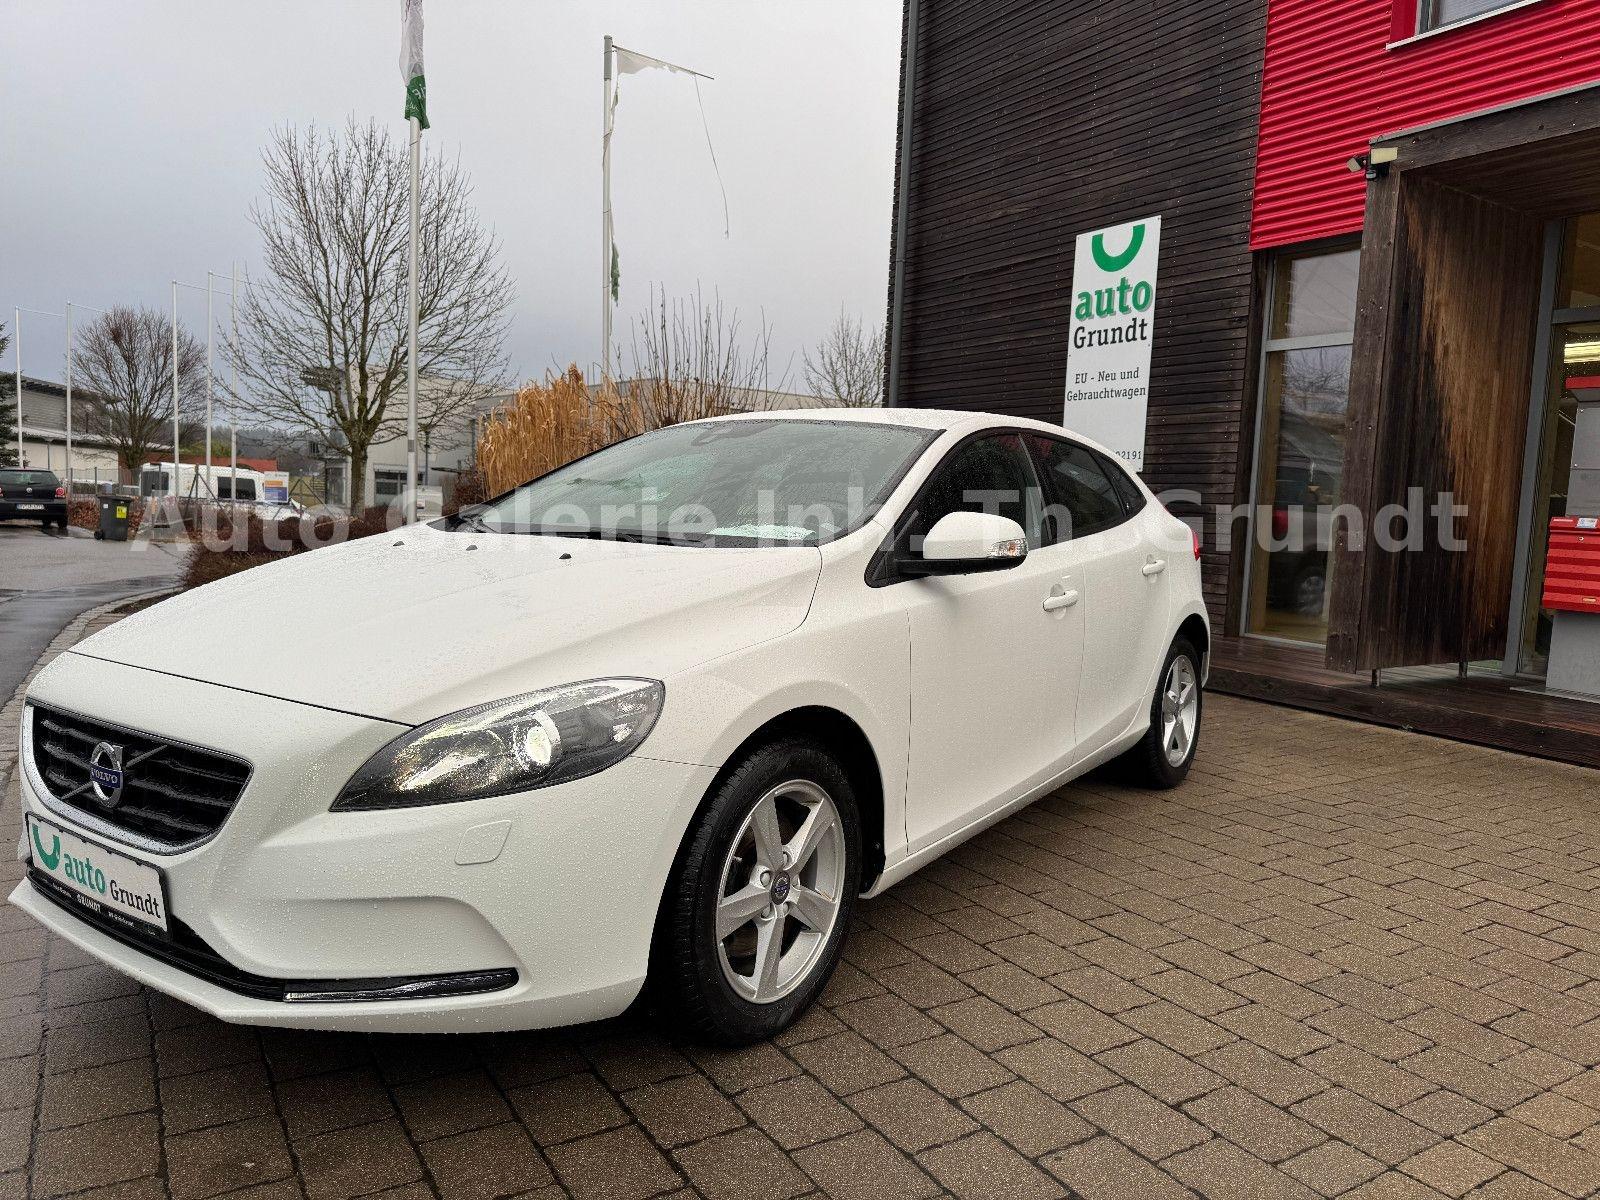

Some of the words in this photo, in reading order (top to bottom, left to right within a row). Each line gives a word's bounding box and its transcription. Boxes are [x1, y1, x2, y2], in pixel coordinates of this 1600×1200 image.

[1075, 277, 1153, 321] auto
[1073, 317, 1148, 349] Grundt
[1075, 373, 1088, 384] EU
[1098, 371, 1117, 382] Neu
[1120, 366, 1140, 380] und
[1066, 387, 1146, 401] Gebrauchtwagen
[91, 766, 118, 784] VOLVO
[63, 852, 105, 894] auto
[109, 879, 162, 919] Grundt
